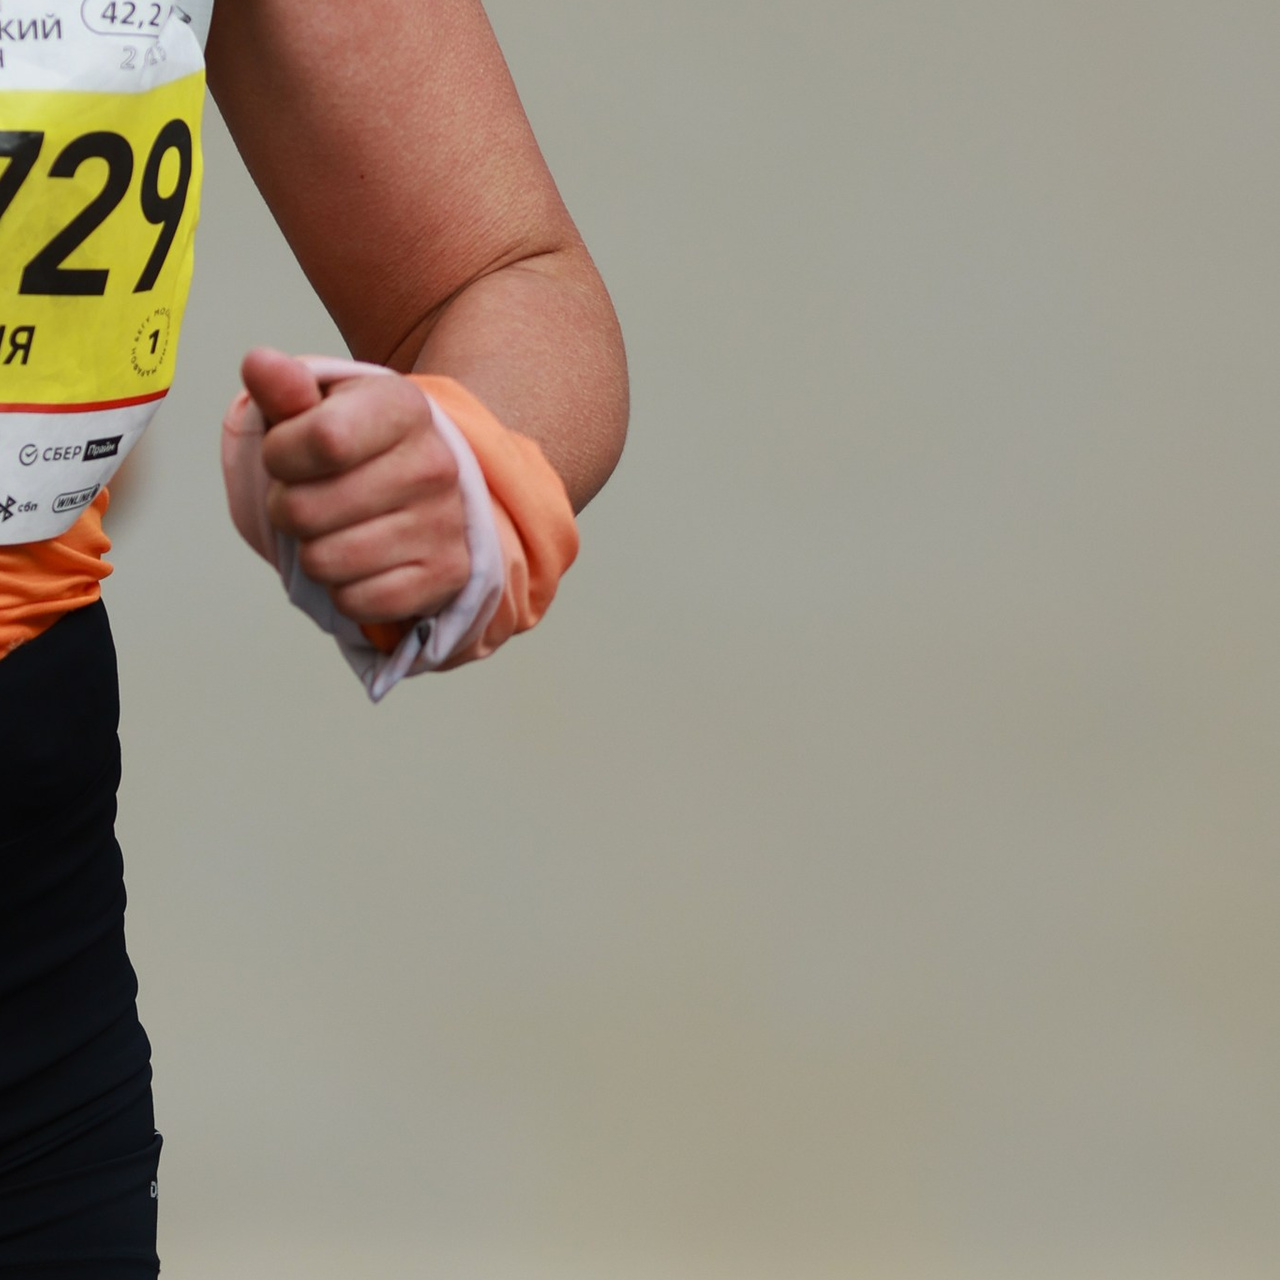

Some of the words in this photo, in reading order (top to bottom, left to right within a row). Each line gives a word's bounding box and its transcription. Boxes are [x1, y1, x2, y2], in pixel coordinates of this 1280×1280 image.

[149, 329, 160, 354] 1
[42, 446, 82, 462] СБЕР
[18, 501, 38, 513] сбп
[56, 491, 91, 508] WINLINE
